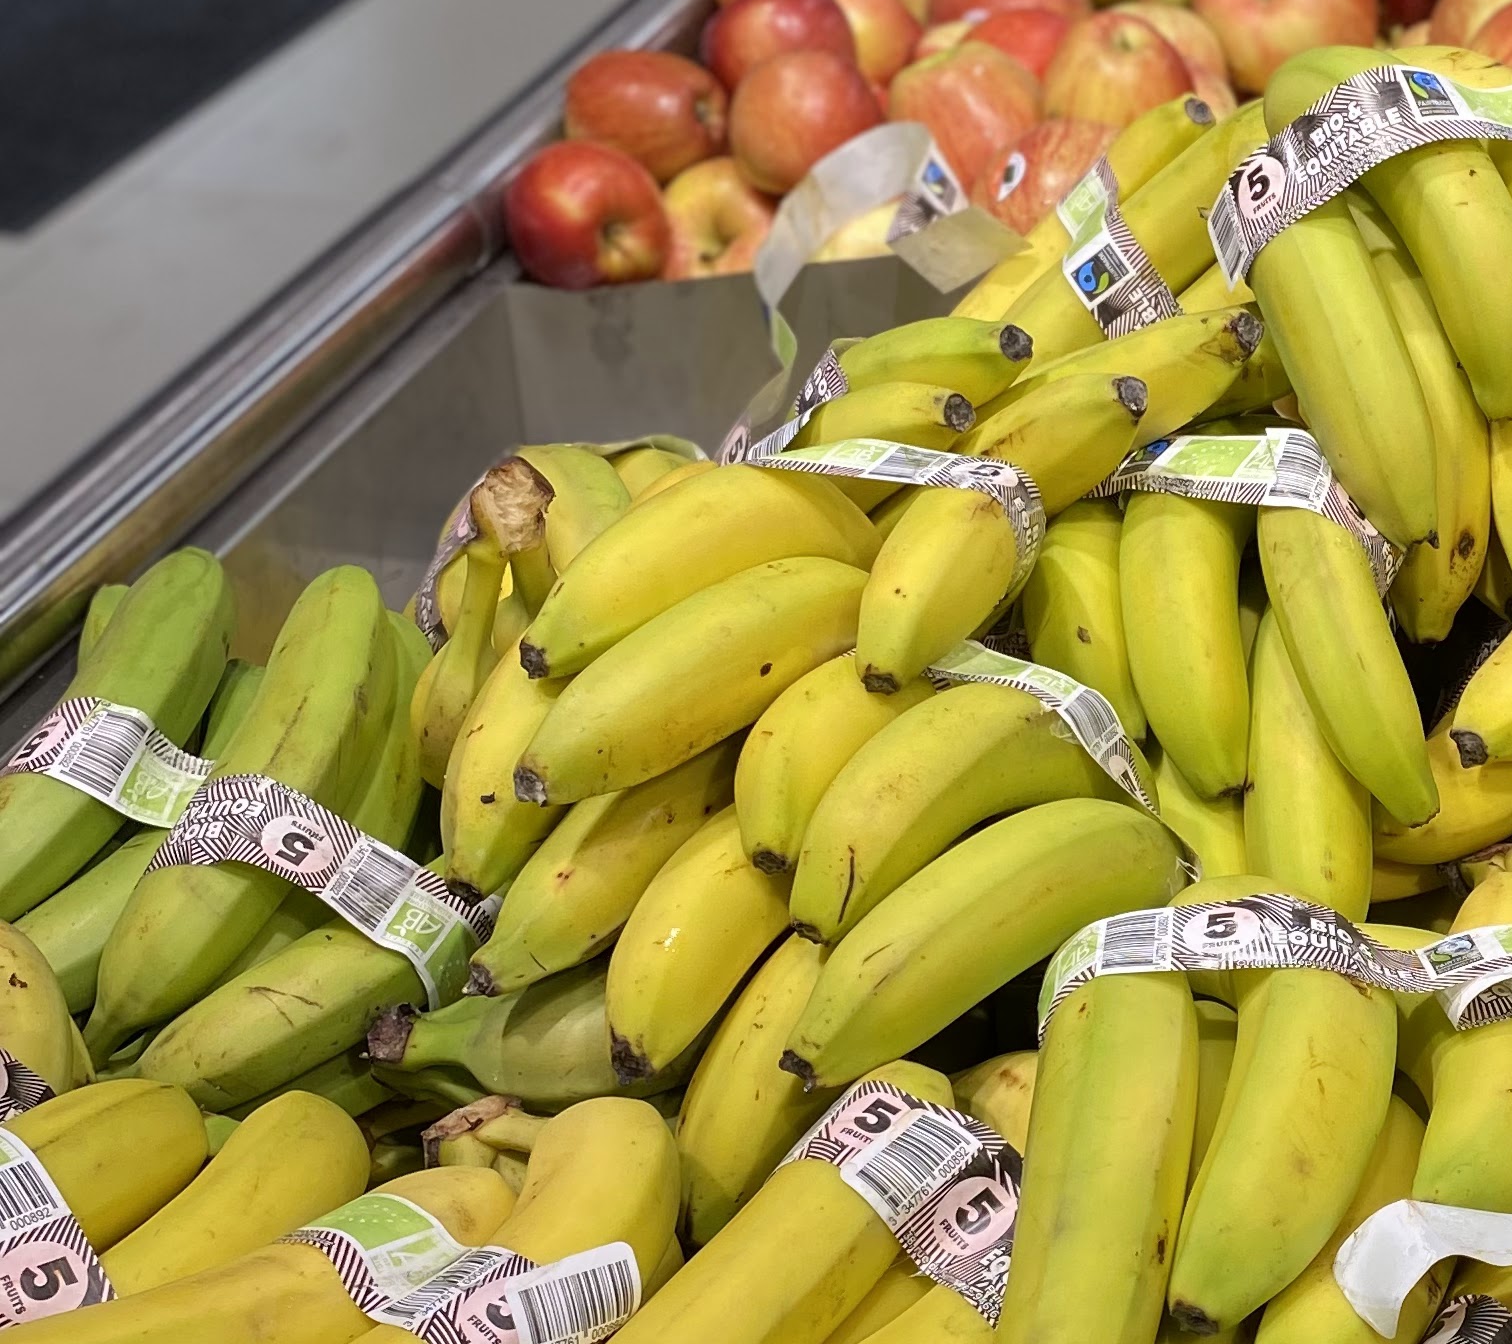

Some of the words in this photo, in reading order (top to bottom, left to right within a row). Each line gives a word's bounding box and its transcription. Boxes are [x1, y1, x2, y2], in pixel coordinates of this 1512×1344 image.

[1310, 113, 1344, 148] BIO
[1246, 164, 1271, 201] 5
[1252, 192, 1277, 215] FRUITS
[290, 820, 329, 842] FRUITS
[275, 831, 316, 867] 5
[1203, 911, 1237, 940] 5
[1310, 917, 1354, 944] BIO
[854, 1098, 901, 1135] 5
[938, 1146, 971, 1179] 000892
[904, 1183, 935, 1215] 347761
[955, 1187, 1006, 1236] 5
[9, 1207, 54, 1232] 000892
[888, 1216, 898, 1226] 3
[939, 1218, 970, 1251] FRUITS
[0, 1274, 27, 1316] FRUITS
[19, 1256, 79, 1302] 5
